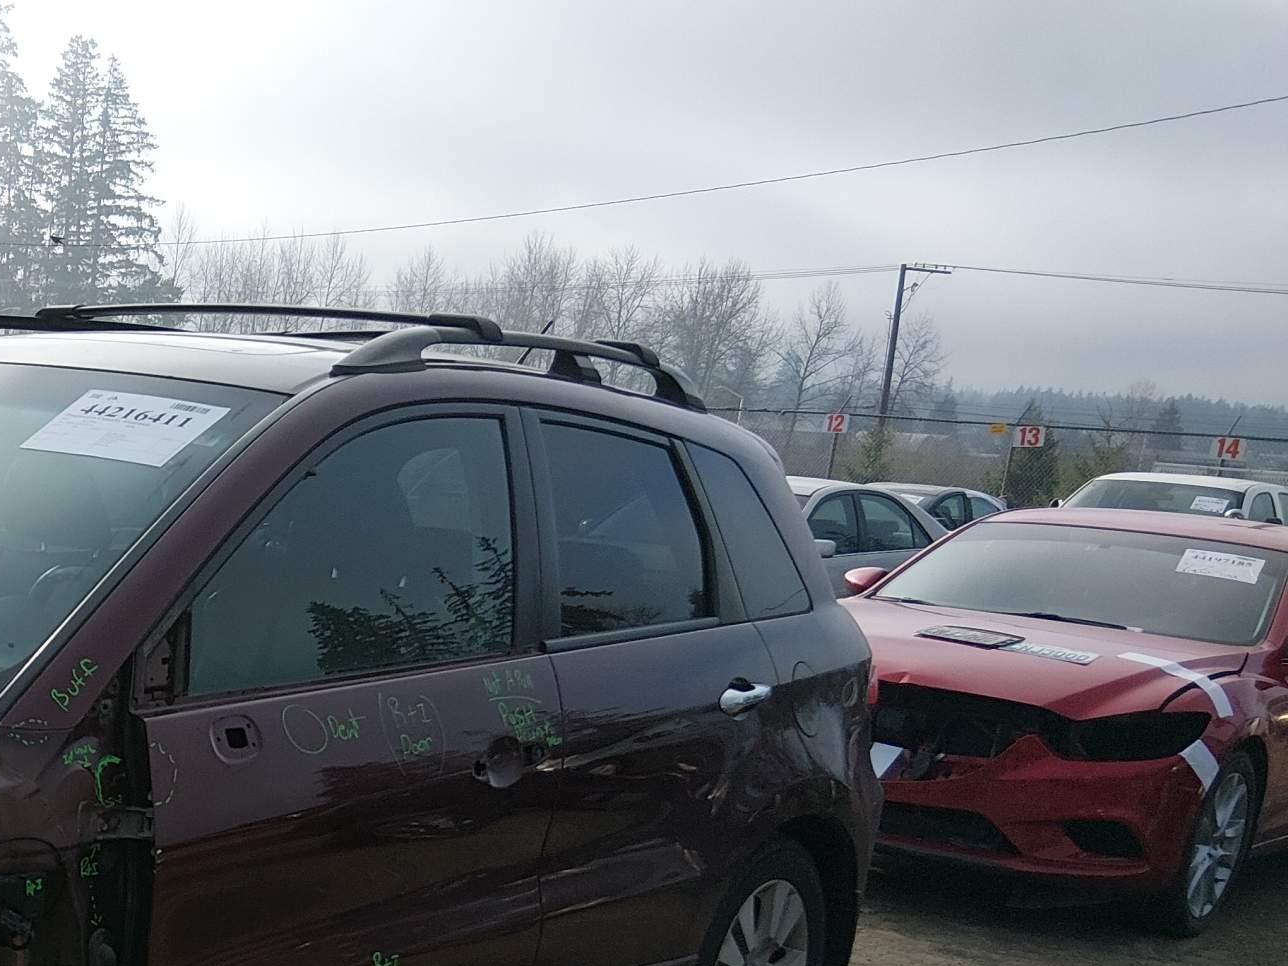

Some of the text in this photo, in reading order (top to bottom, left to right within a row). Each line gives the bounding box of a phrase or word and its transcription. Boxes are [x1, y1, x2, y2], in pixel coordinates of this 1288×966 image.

[81, 403, 193, 428] 44216411
[826, 414, 845, 433] 12
[1019, 427, 1041, 447] 13
[1216, 437, 1240, 460] 14
